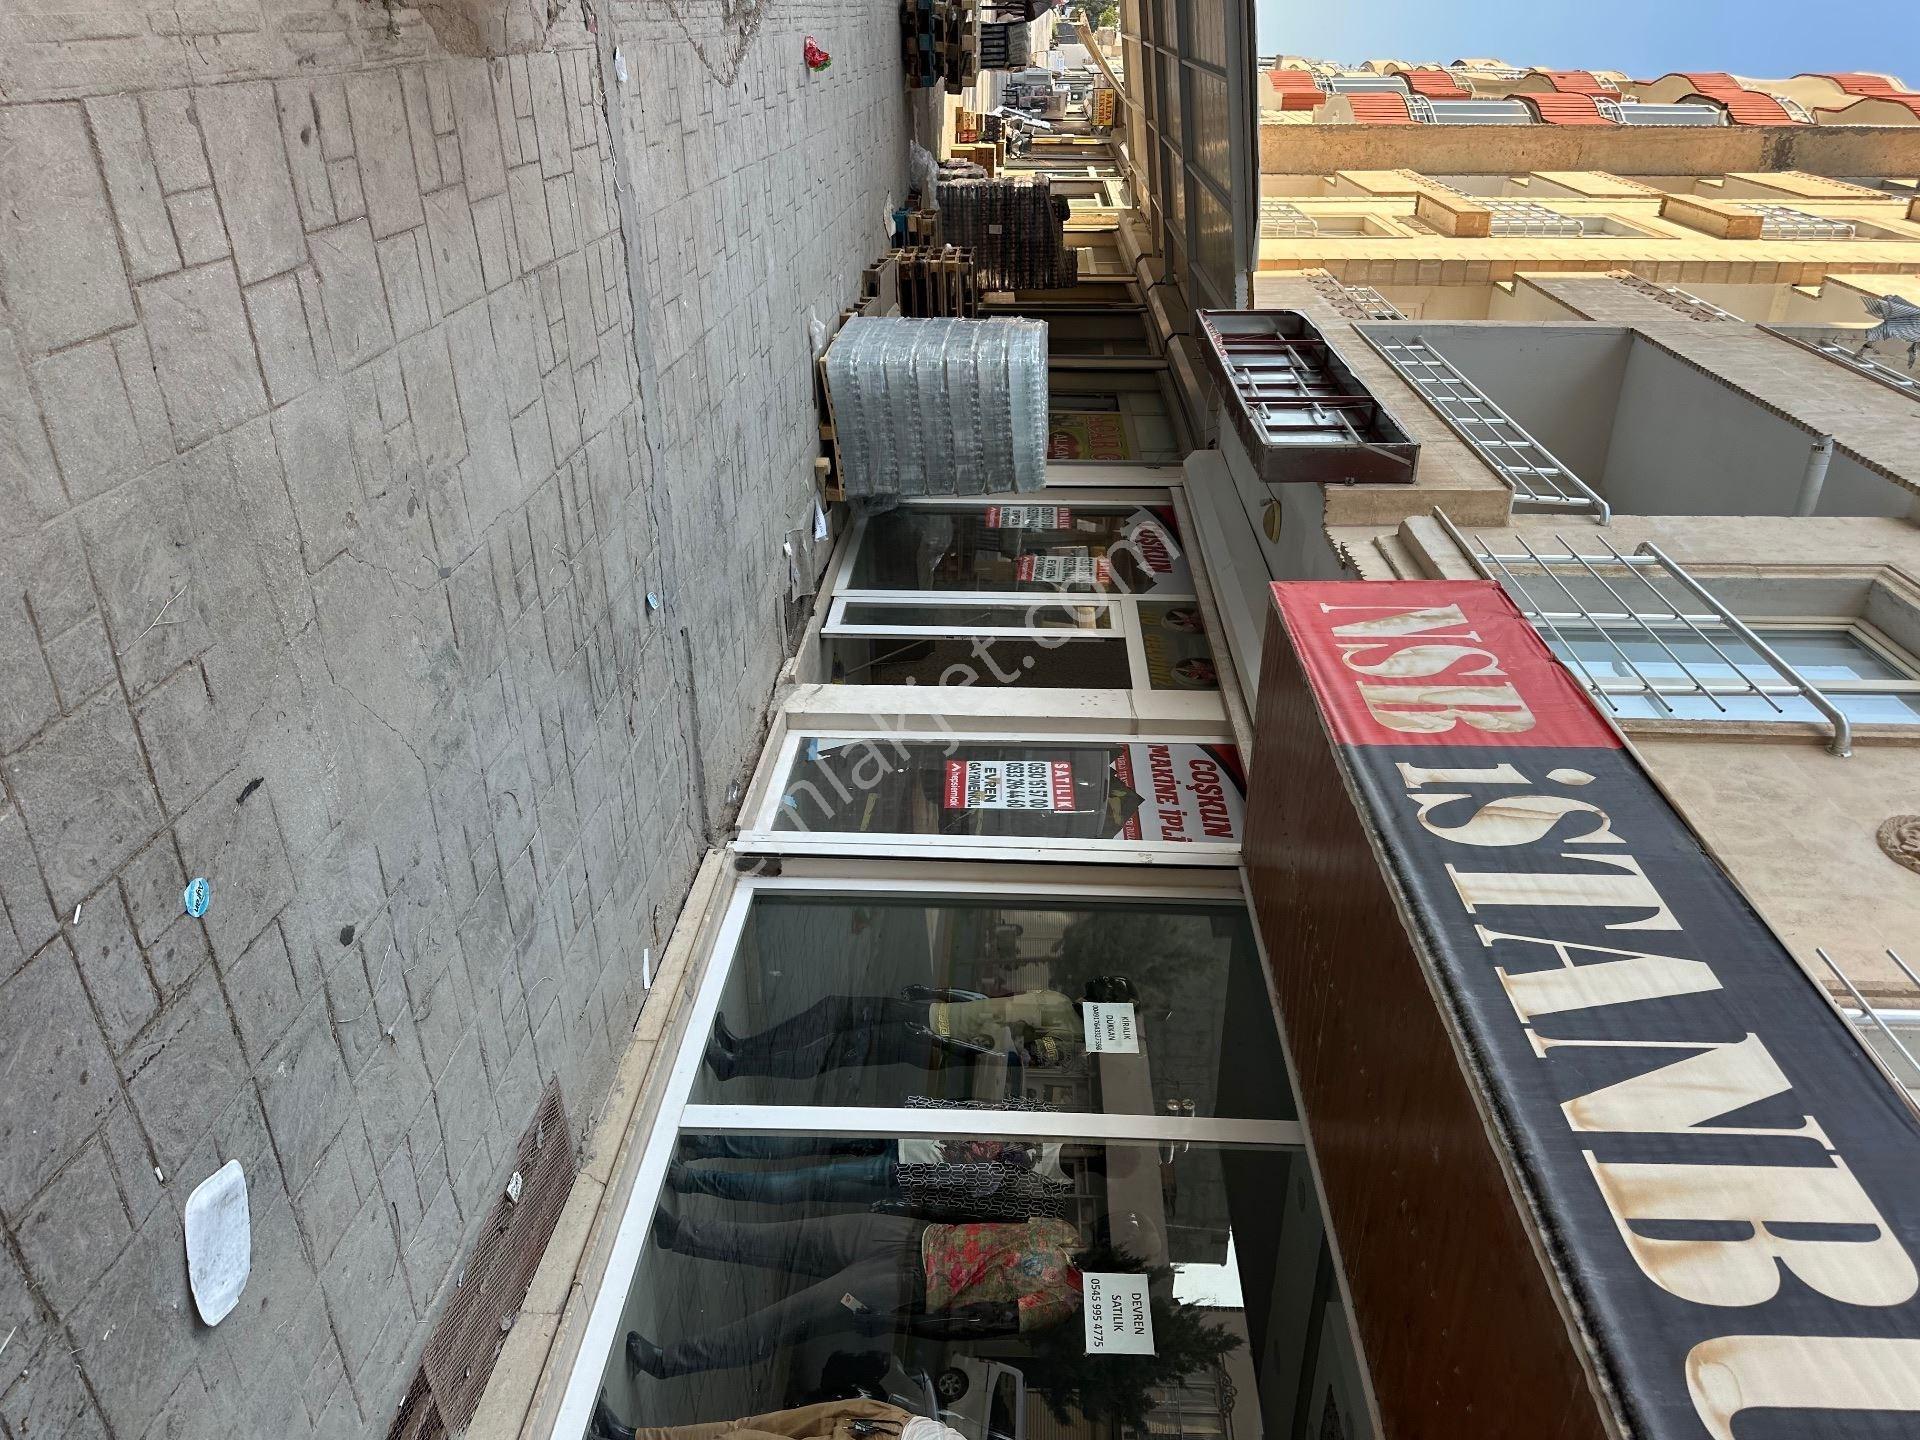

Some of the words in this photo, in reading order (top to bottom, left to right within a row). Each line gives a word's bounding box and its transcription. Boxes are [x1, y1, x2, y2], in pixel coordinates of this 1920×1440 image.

[1105, 93, 1113, 121] BALTA
[1046, 559, 1057, 579] EVREN
[1320, 602, 1537, 734] NSB
[1006, 762, 1024, 778] 0533
[1028, 762, 1047, 779] 0530
[1147, 744, 1182, 806] MAKİNE
[948, 771, 961, 807] hepsiemlak
[967, 762, 984, 808] GAYRİMENKUL
[984, 767, 997, 803] EVREN
[1006, 778, 1025, 789] 296
[1006, 790, 1025, 798] 44
[1028, 780, 1047, 789] 151
[1029, 790, 1048, 798] 57
[1054, 762, 1073, 809] SATILIK
[1006, 799, 1026, 808] 60
[1029, 799, 1049, 808] 00
[1186, 759, 1234, 839] COŞKUN
[194, 881, 204, 913] Ayran
[1105, 1014, 1116, 1041] DÜKKAN
[1121, 1016, 1132, 1040] KİRALIK
[1091, 1278, 1101, 1301] 0545
[1092, 1304, 1102, 1321] 995
[1112, 1294, 1124, 1332] SATILIK
[1132, 1293, 1145, 1335] DEVREN
[1093, 1323, 1104, 1347] 4775
